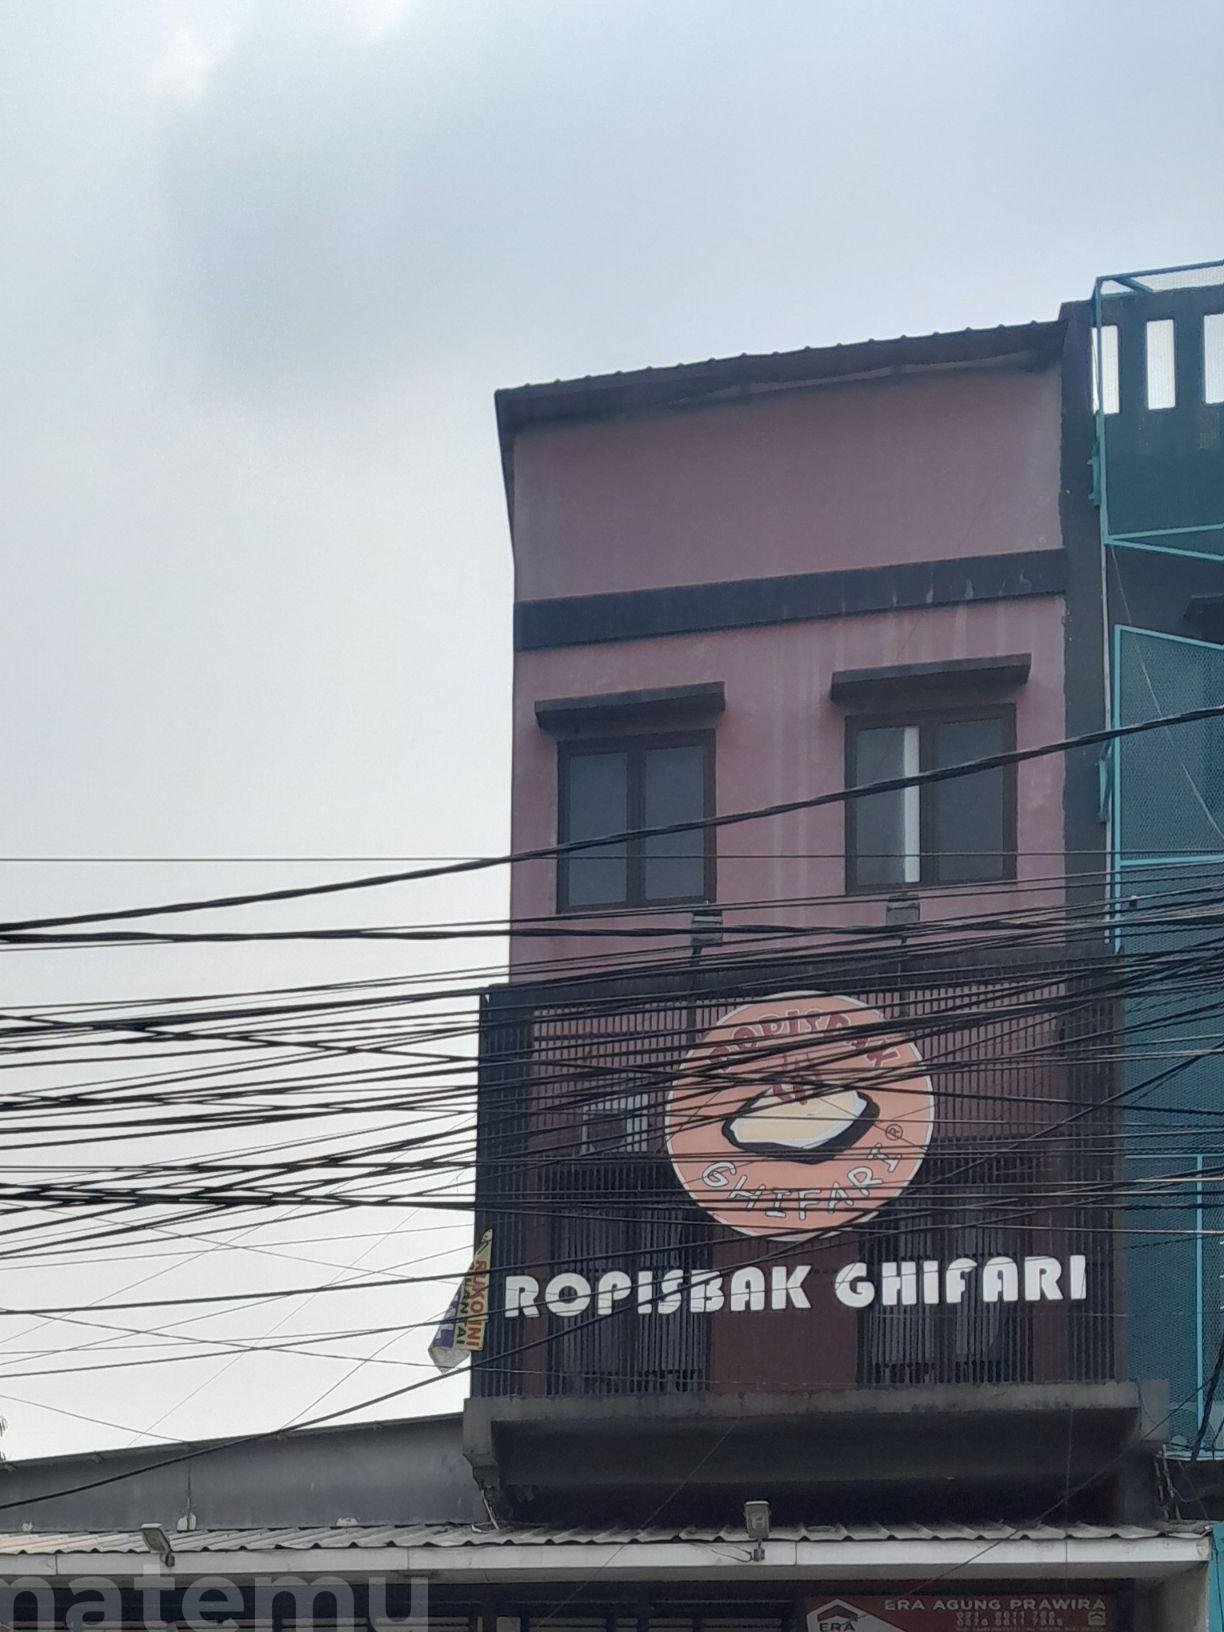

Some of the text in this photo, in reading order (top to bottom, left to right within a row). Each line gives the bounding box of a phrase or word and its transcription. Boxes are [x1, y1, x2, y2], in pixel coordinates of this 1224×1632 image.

[702, 1141, 902, 1220] GHIFARI
[504, 1254, 1087, 1319] ROPISBAK GHIFARI
[884, 1598, 1107, 1611] ERA AGUNG PRAWIRA
[819, 1621, 855, 1632] ERA
